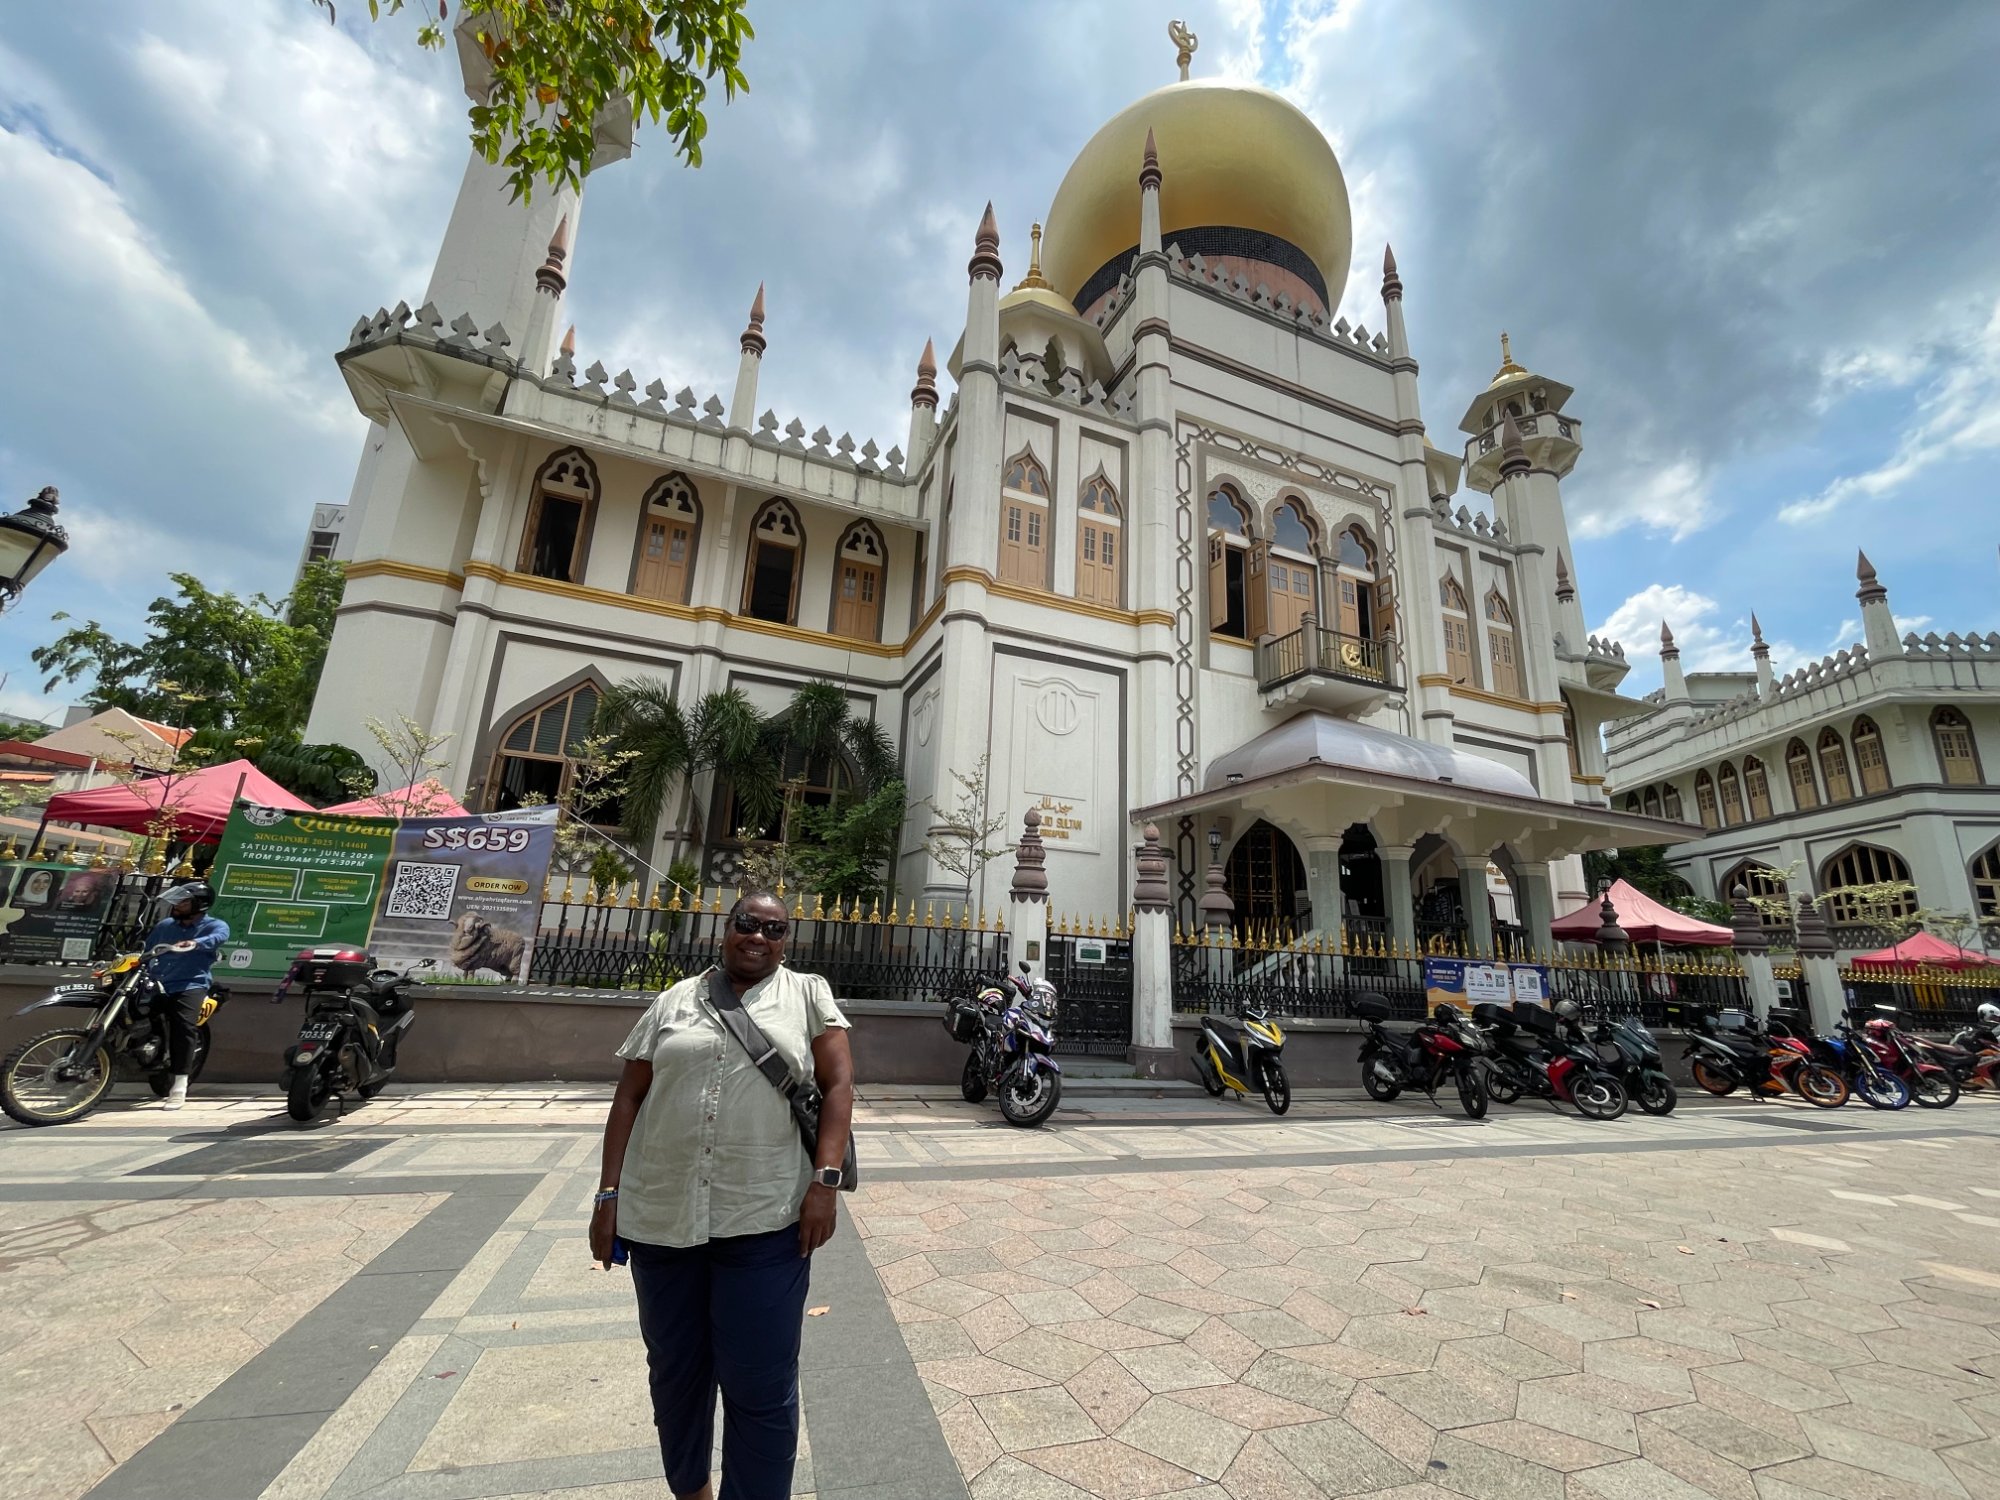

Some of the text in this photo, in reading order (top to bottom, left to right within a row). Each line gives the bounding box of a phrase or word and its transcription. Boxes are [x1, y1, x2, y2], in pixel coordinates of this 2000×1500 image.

[294, 815, 392, 836] Qurban
[1057, 818, 1082, 830] SULTAN
[254, 833, 309, 844] SINGAPORE
[340, 842, 368, 850] 1446H
[423, 827, 530, 852] S$659
[241, 842, 298, 853] SATURDAY
[319, 850, 347, 858] JUNE
[350, 852, 374, 860] 2025
[243, 852, 272, 861] FROM
[275, 855, 312, 864] 9:30AM
[330, 859, 365, 867] 5:30PM
[474, 881, 500, 889] ORDER
[312, 1023, 327, 1031] FY
[300, 1031, 333, 1039] 7033G
